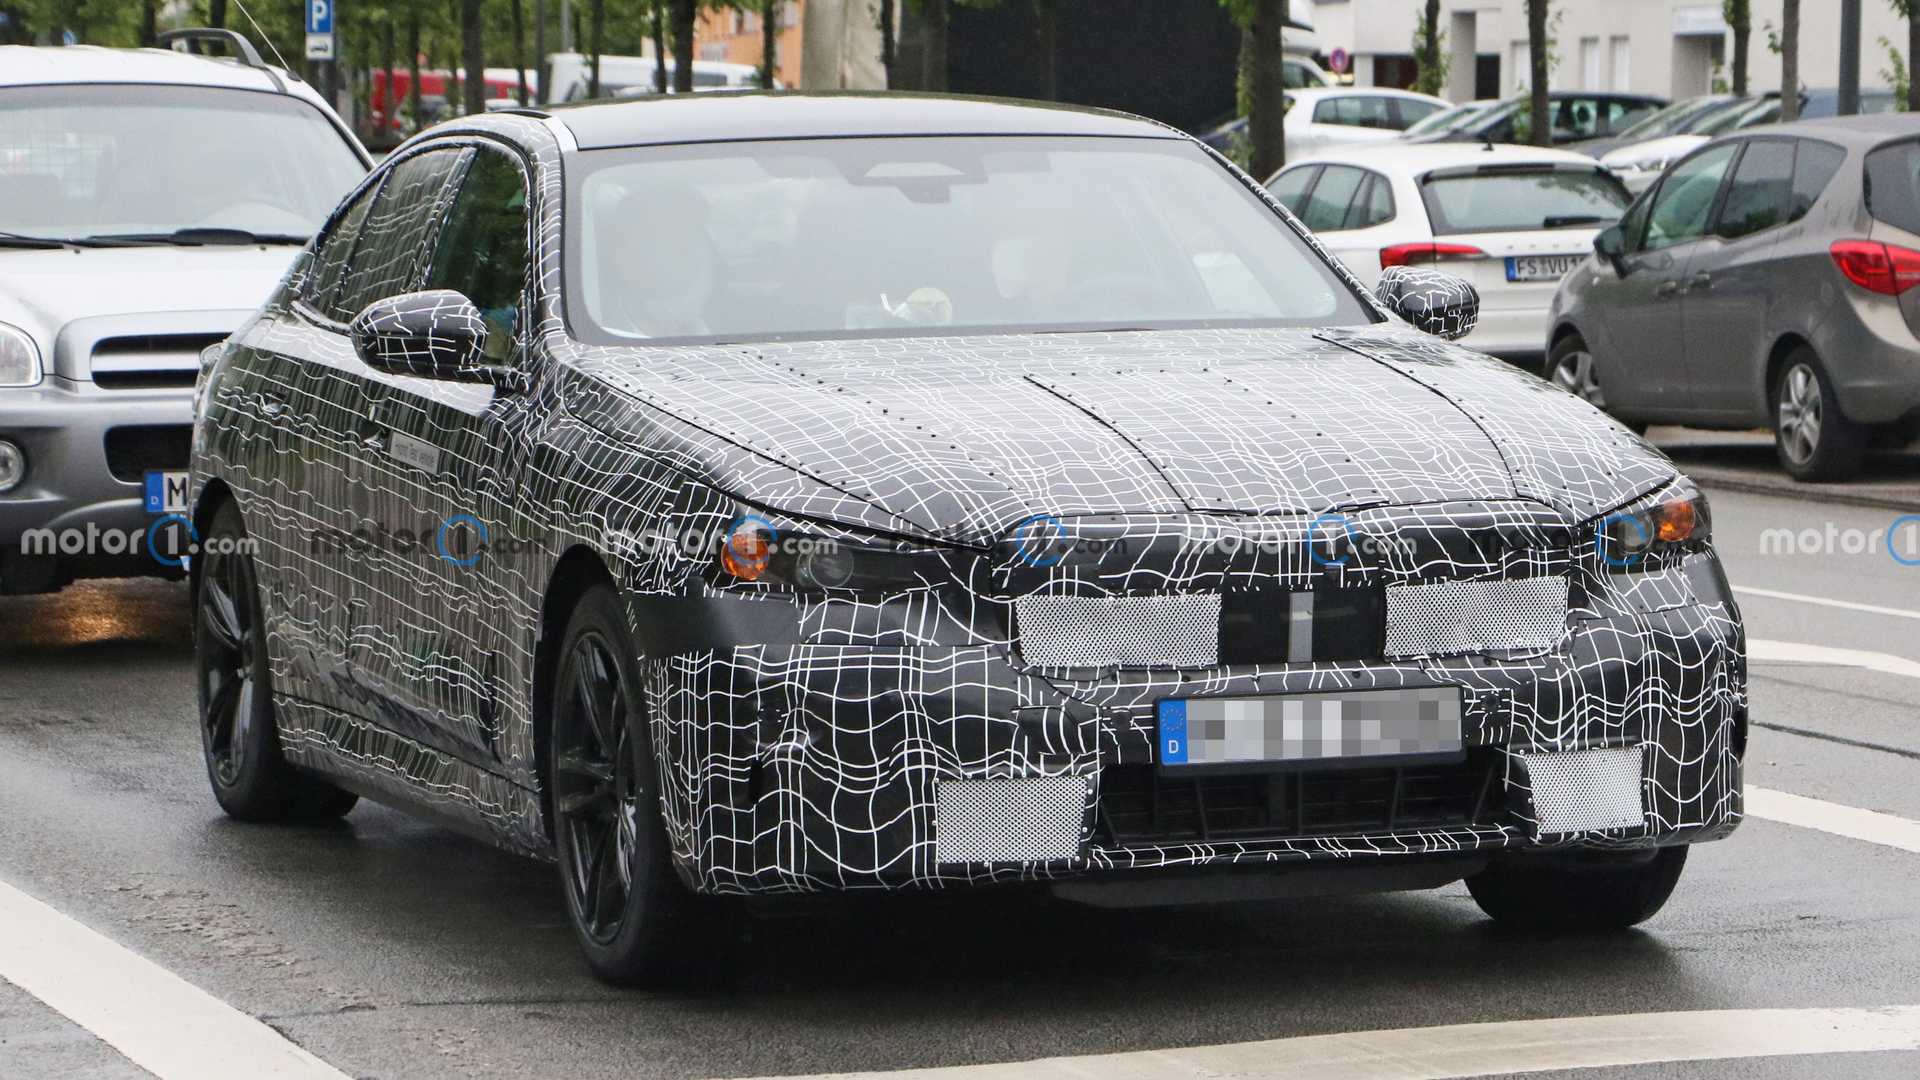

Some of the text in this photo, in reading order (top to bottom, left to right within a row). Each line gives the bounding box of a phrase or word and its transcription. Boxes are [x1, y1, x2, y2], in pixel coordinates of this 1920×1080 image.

[312, 0, 328, 31] P
[1517, 259, 1537, 274] FS
[150, 476, 187, 506] D M
[1168, 739, 1180, 754] D
